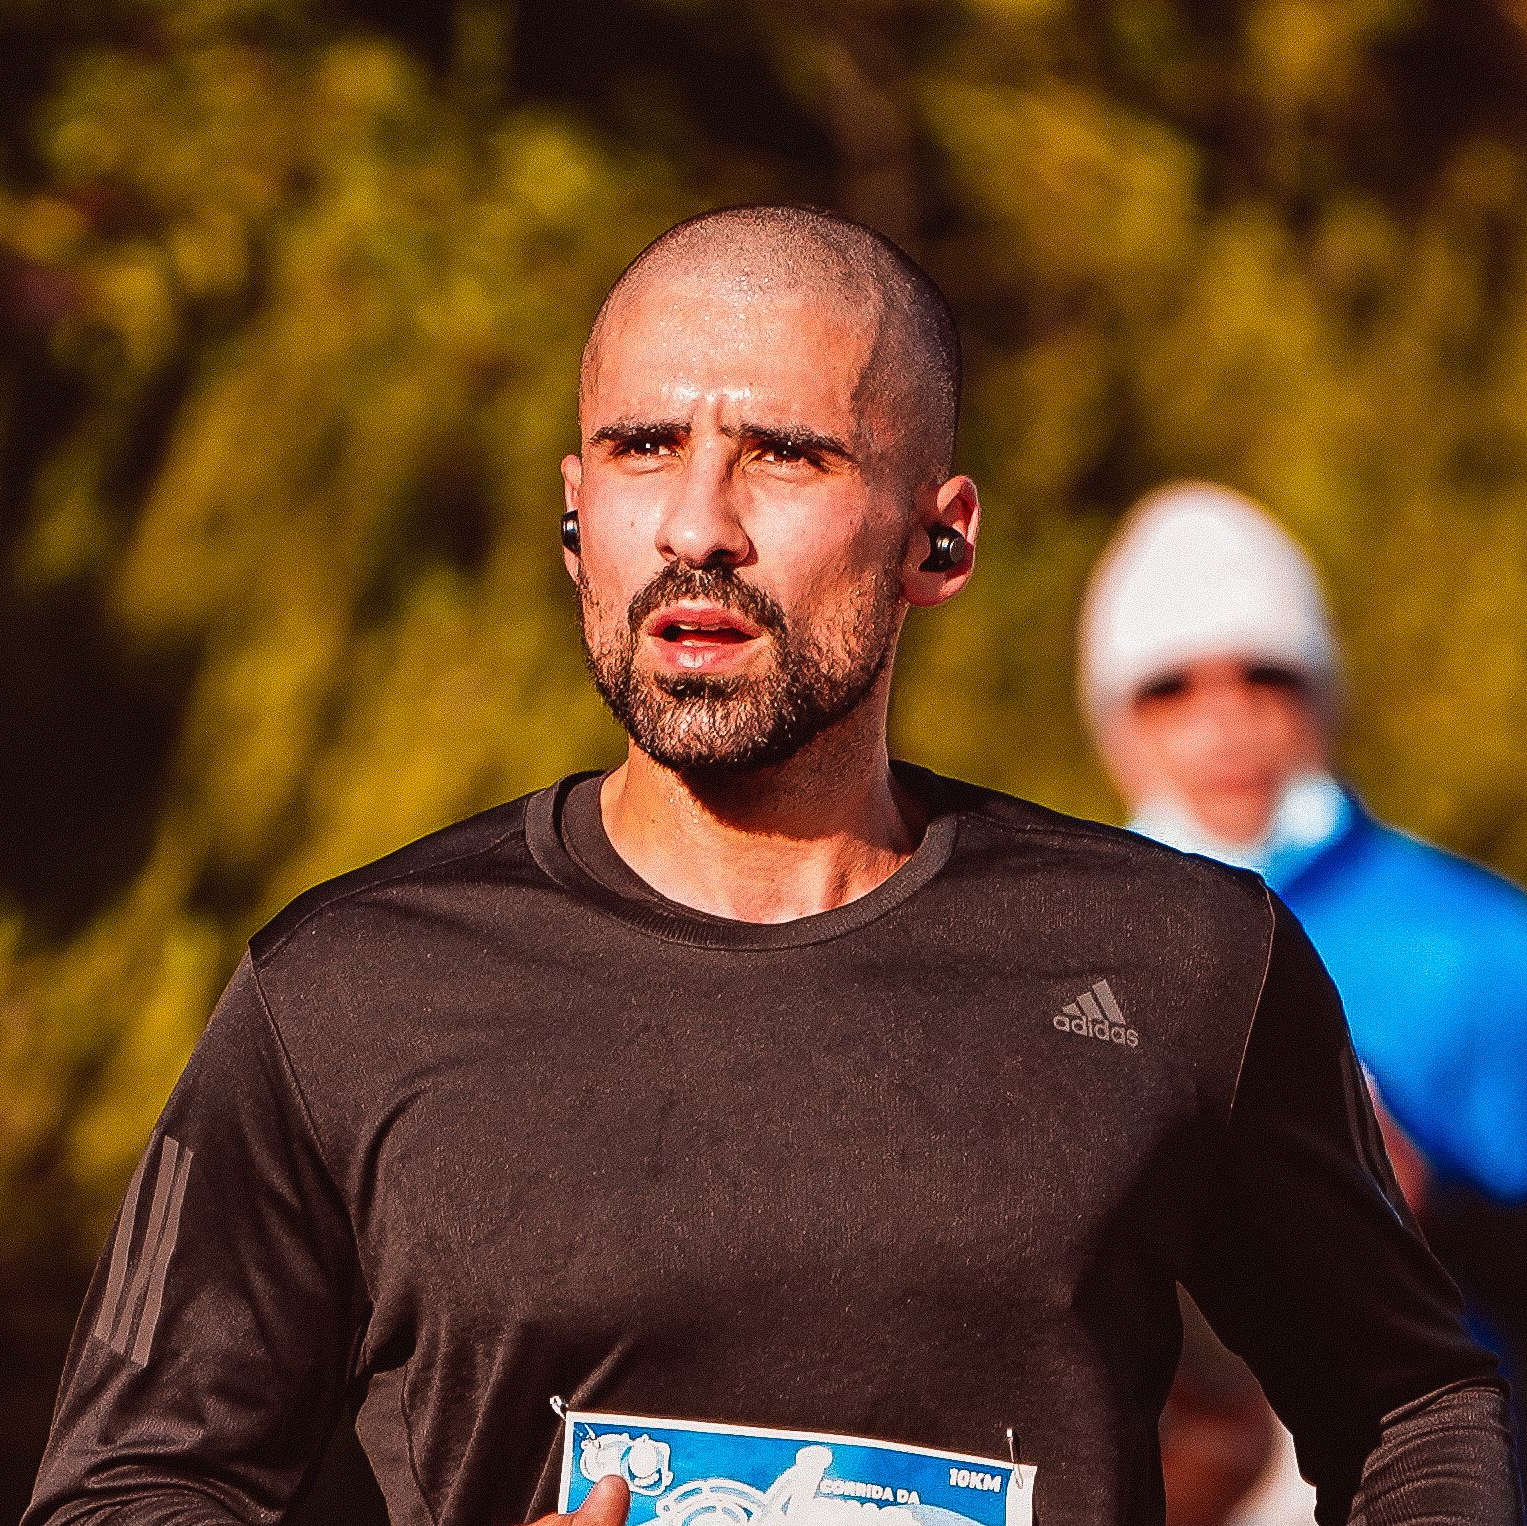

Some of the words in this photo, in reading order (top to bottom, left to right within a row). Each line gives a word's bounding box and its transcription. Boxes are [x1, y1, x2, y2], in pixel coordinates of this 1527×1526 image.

[1052, 1014, 1139, 1049] adidas
[820, 1479, 894, 1501] CORRIDA
[896, 1488, 920, 1505] DA
[949, 1467, 1002, 1493] 10KM
